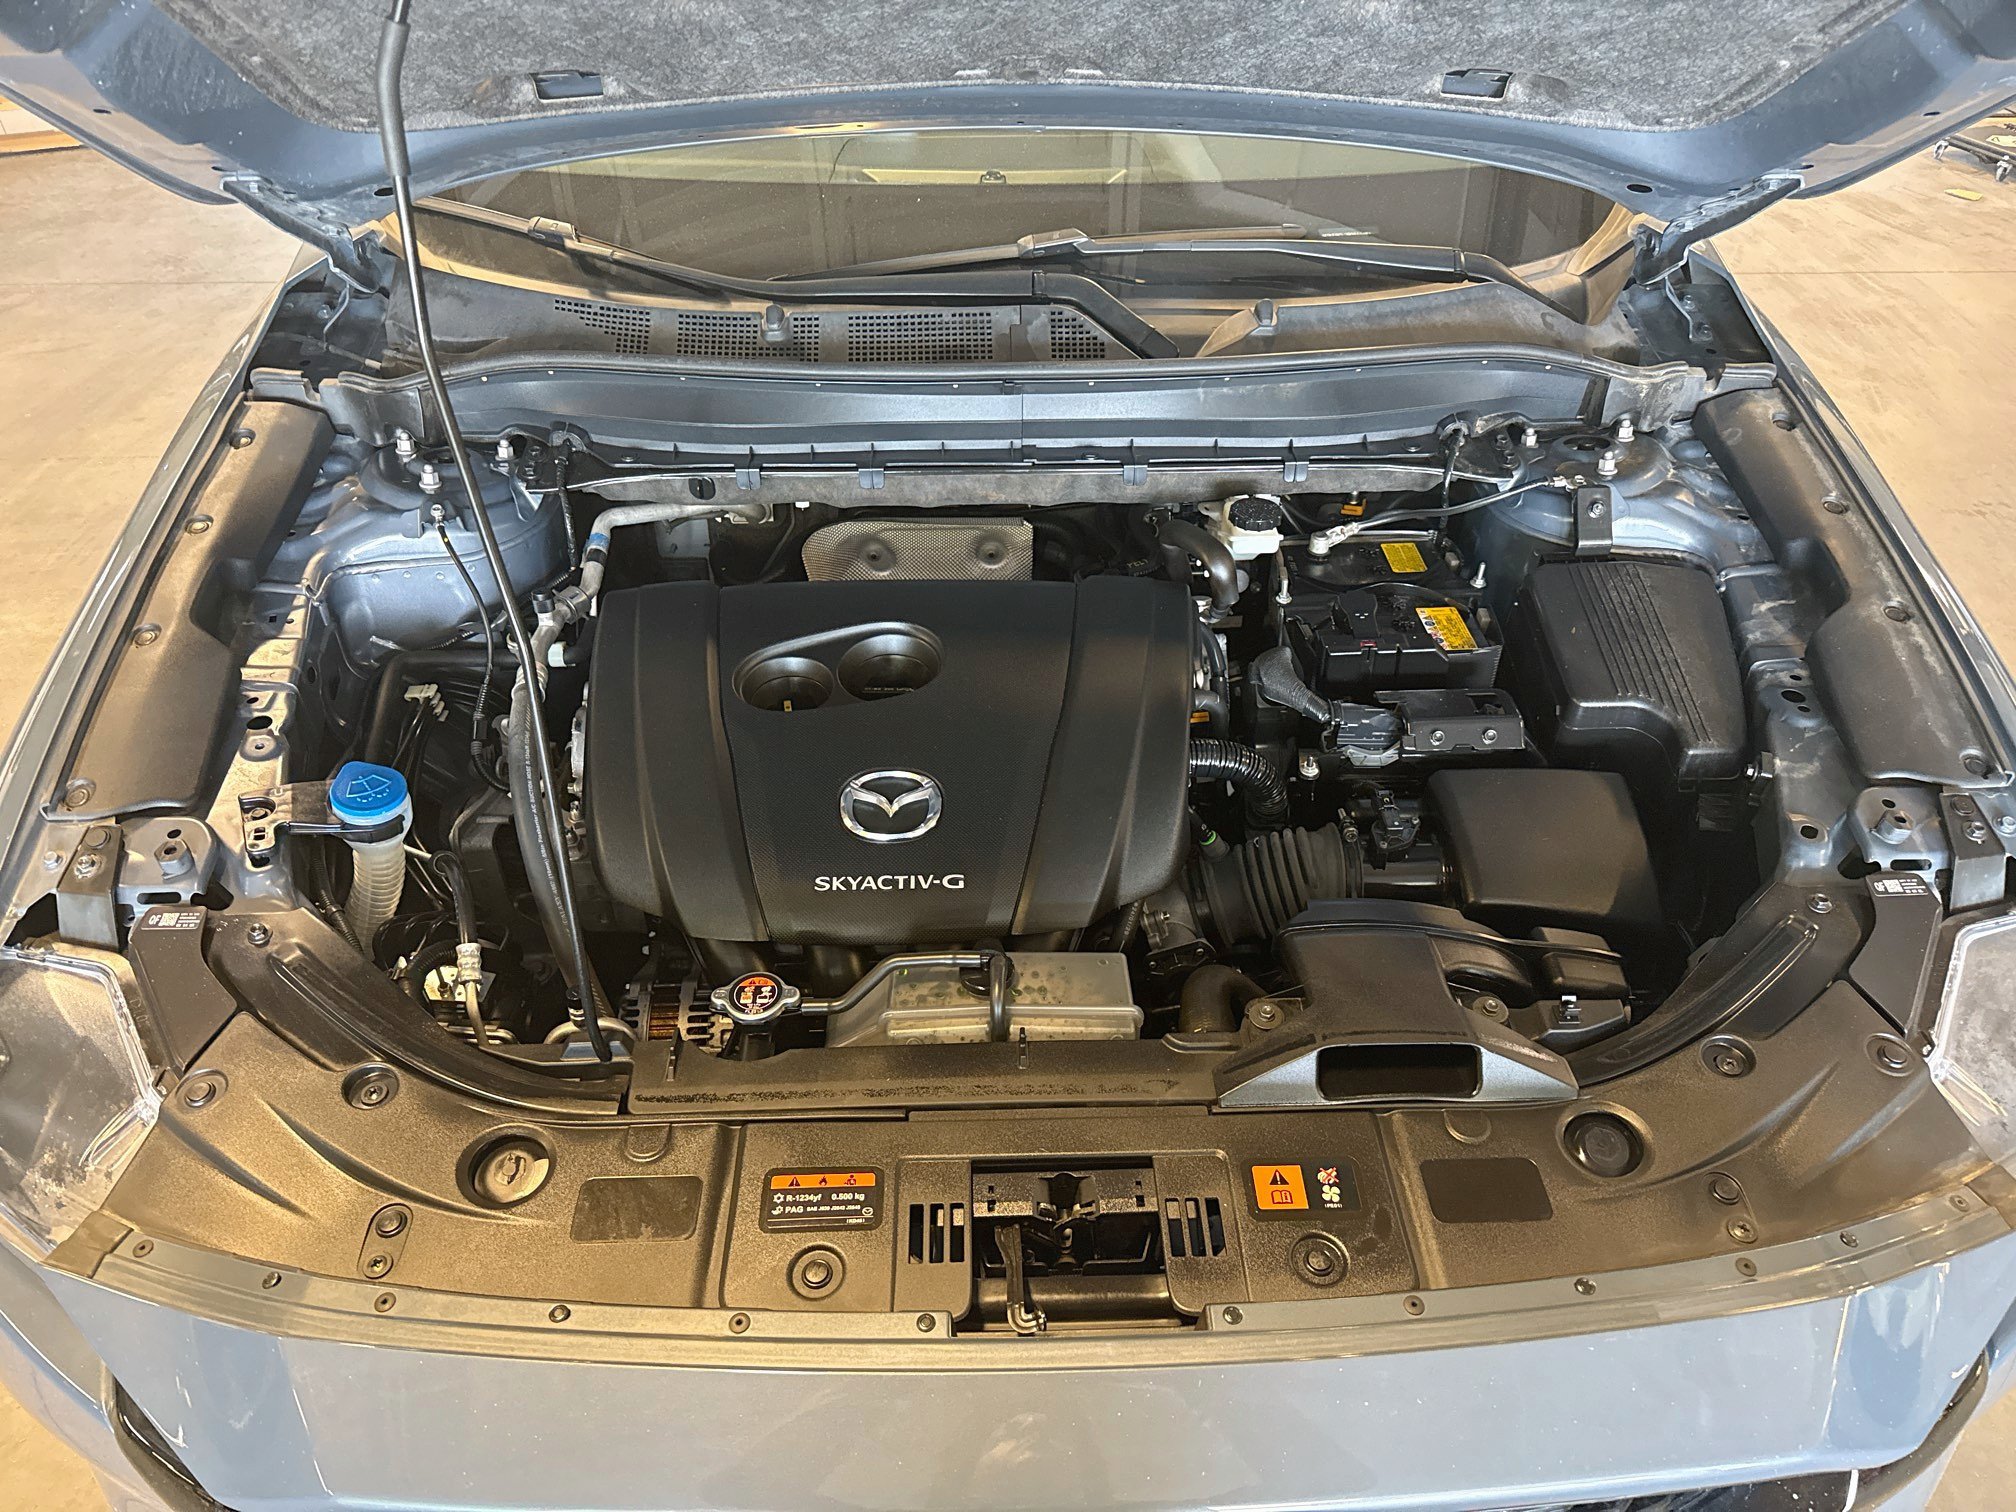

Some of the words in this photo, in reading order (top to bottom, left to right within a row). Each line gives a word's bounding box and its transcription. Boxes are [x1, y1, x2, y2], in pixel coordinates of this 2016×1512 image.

[814, 874, 965, 892] SKYACTIV-G
[786, 1193, 822, 1203] R-1234yf
[831, 1192, 853, 1201] 0.500
[854, 1192, 865, 1202] kg
[785, 1205, 804, 1214] PAG
